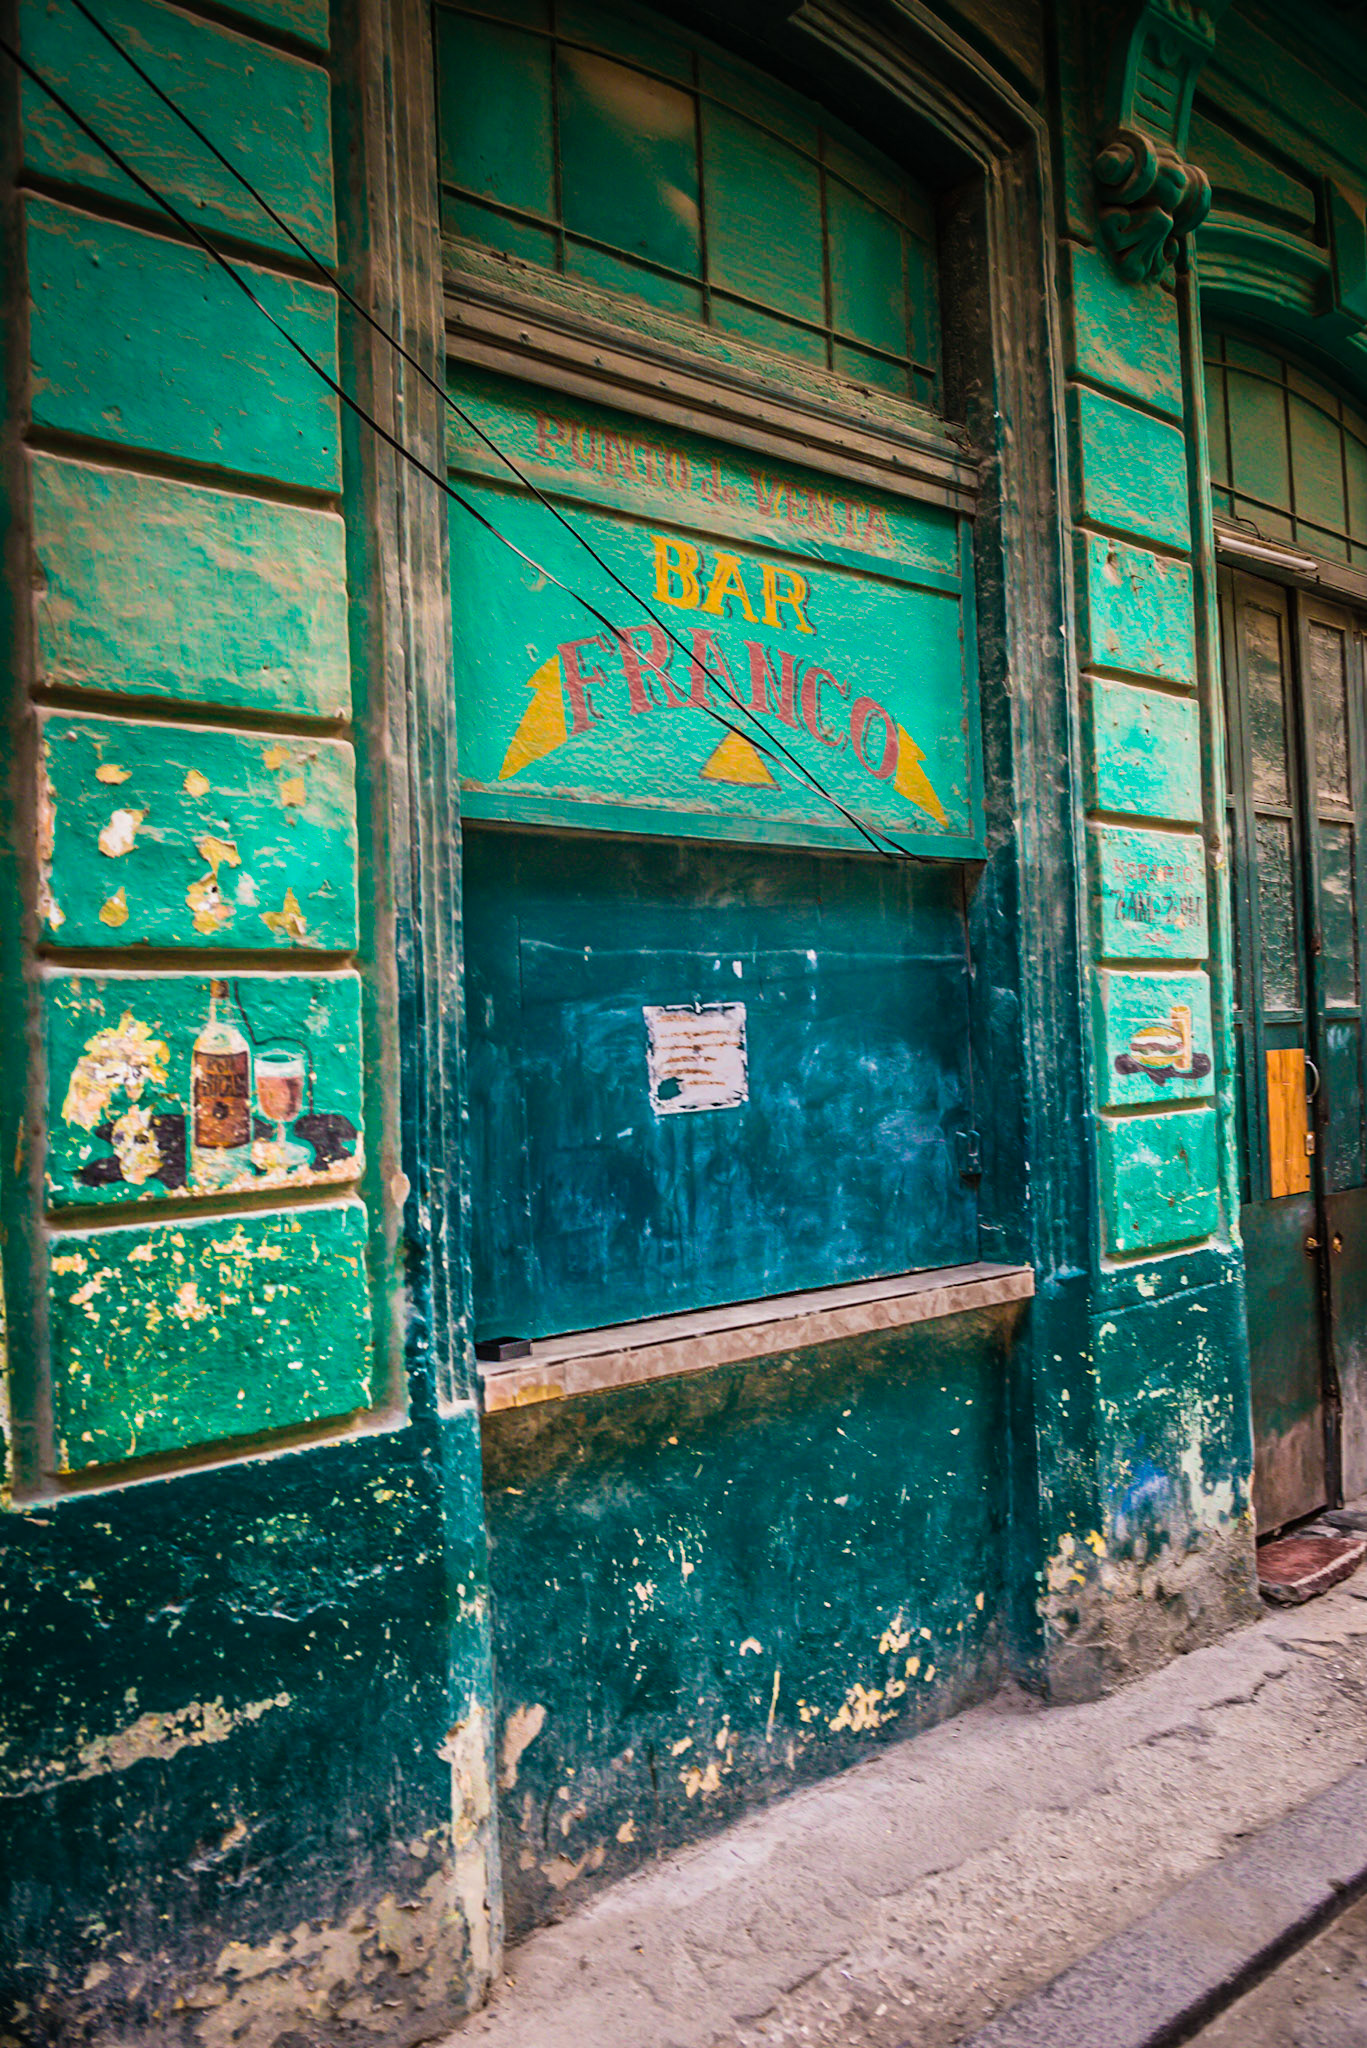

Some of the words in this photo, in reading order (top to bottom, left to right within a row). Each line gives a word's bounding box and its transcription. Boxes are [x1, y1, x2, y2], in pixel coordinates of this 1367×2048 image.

[530, 408, 694, 493] PUNTO
[749, 467, 898, 549] VENTA
[650, 534, 816, 635] BAR
[557, 624, 899, 780] FRANCO
